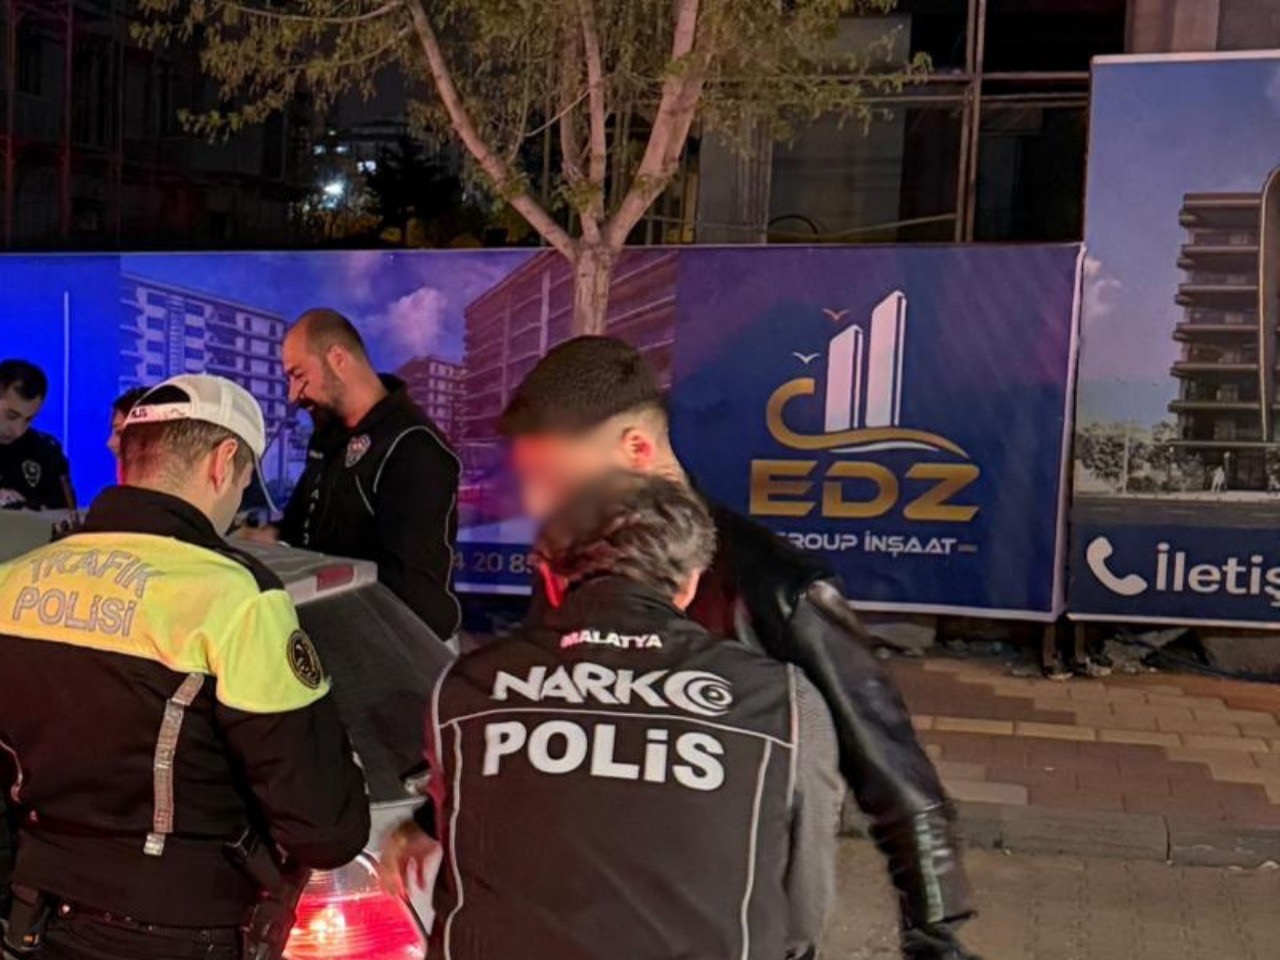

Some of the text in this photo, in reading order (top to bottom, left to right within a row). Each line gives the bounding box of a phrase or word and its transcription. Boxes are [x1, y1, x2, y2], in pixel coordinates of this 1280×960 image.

[749, 460, 981, 522] EDZ
[774, 530, 958, 557] ROUP İNŞAAT
[560, 629, 663, 648] MALATYA
